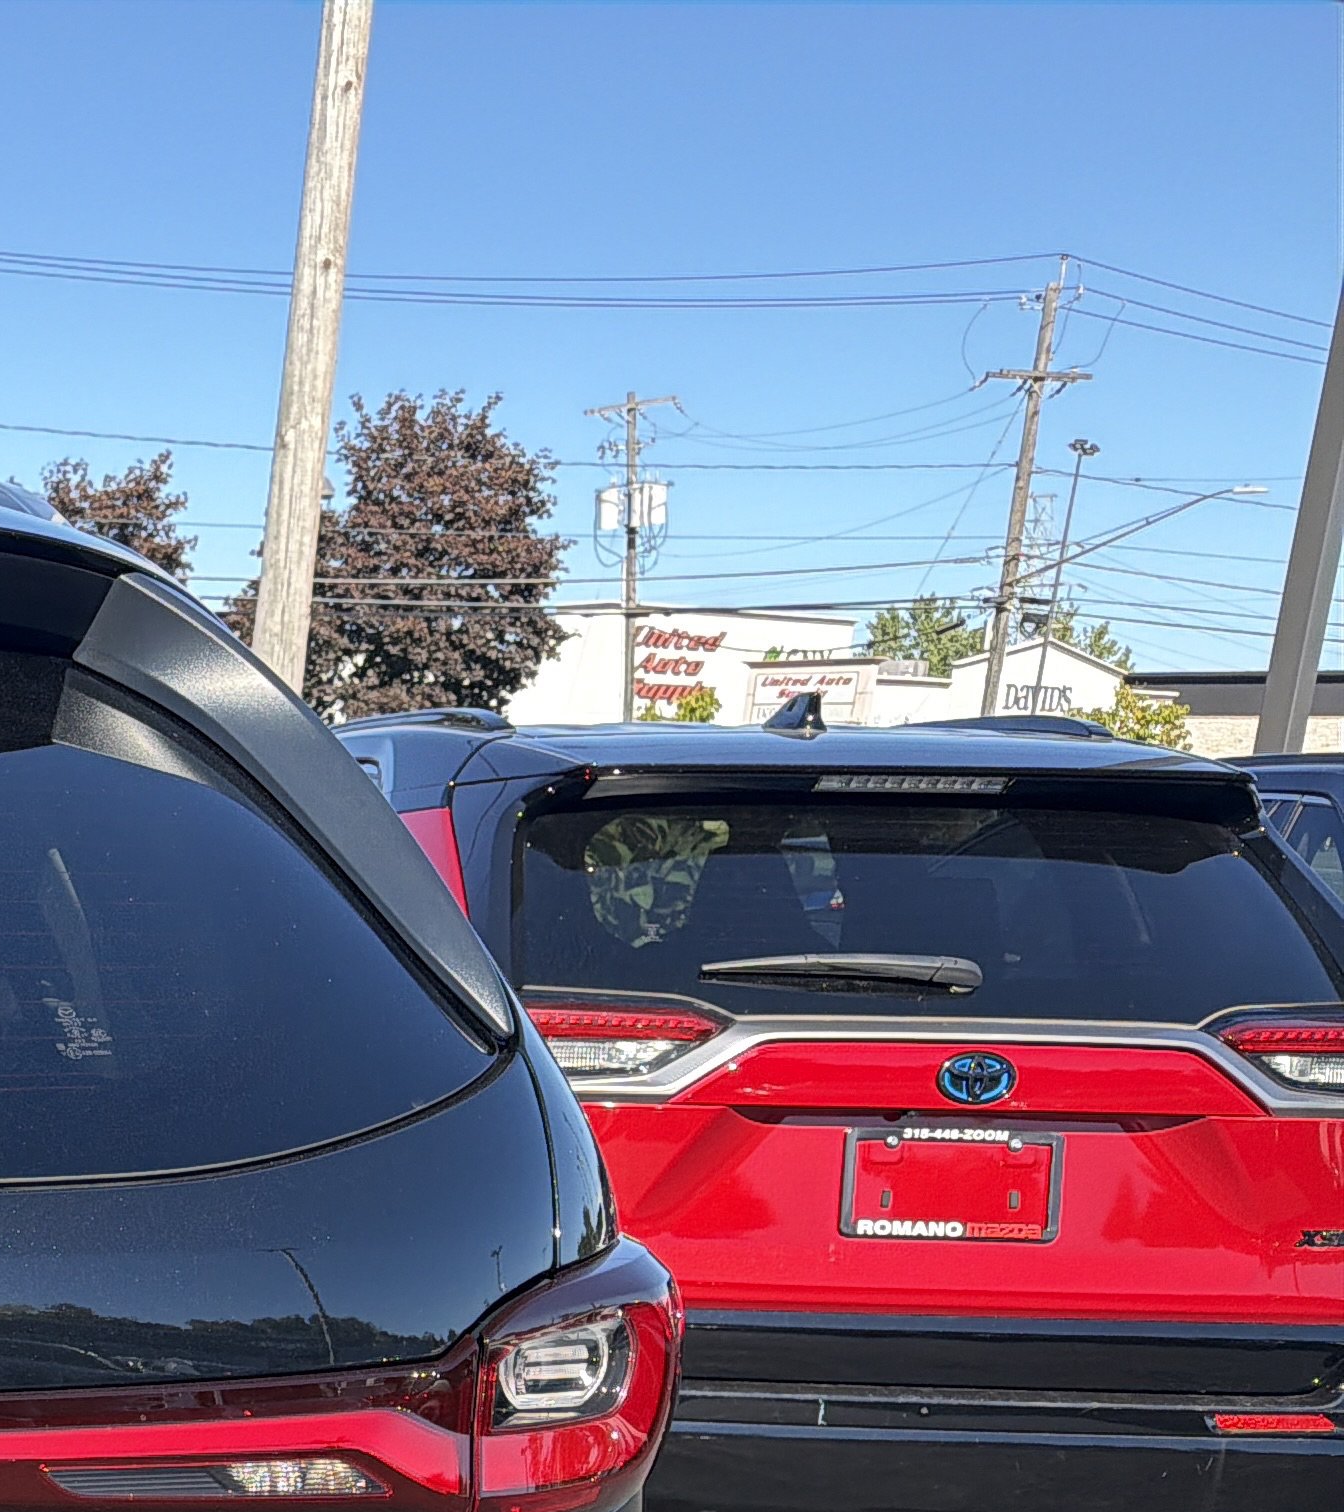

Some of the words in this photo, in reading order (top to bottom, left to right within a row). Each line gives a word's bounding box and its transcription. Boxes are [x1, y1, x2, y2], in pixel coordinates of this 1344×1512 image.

[633, 653, 705, 676] Auto
[761, 675, 812, 687] United
[814, 675, 853, 686] Auto
[856, 1219, 964, 1238] ROMANO
